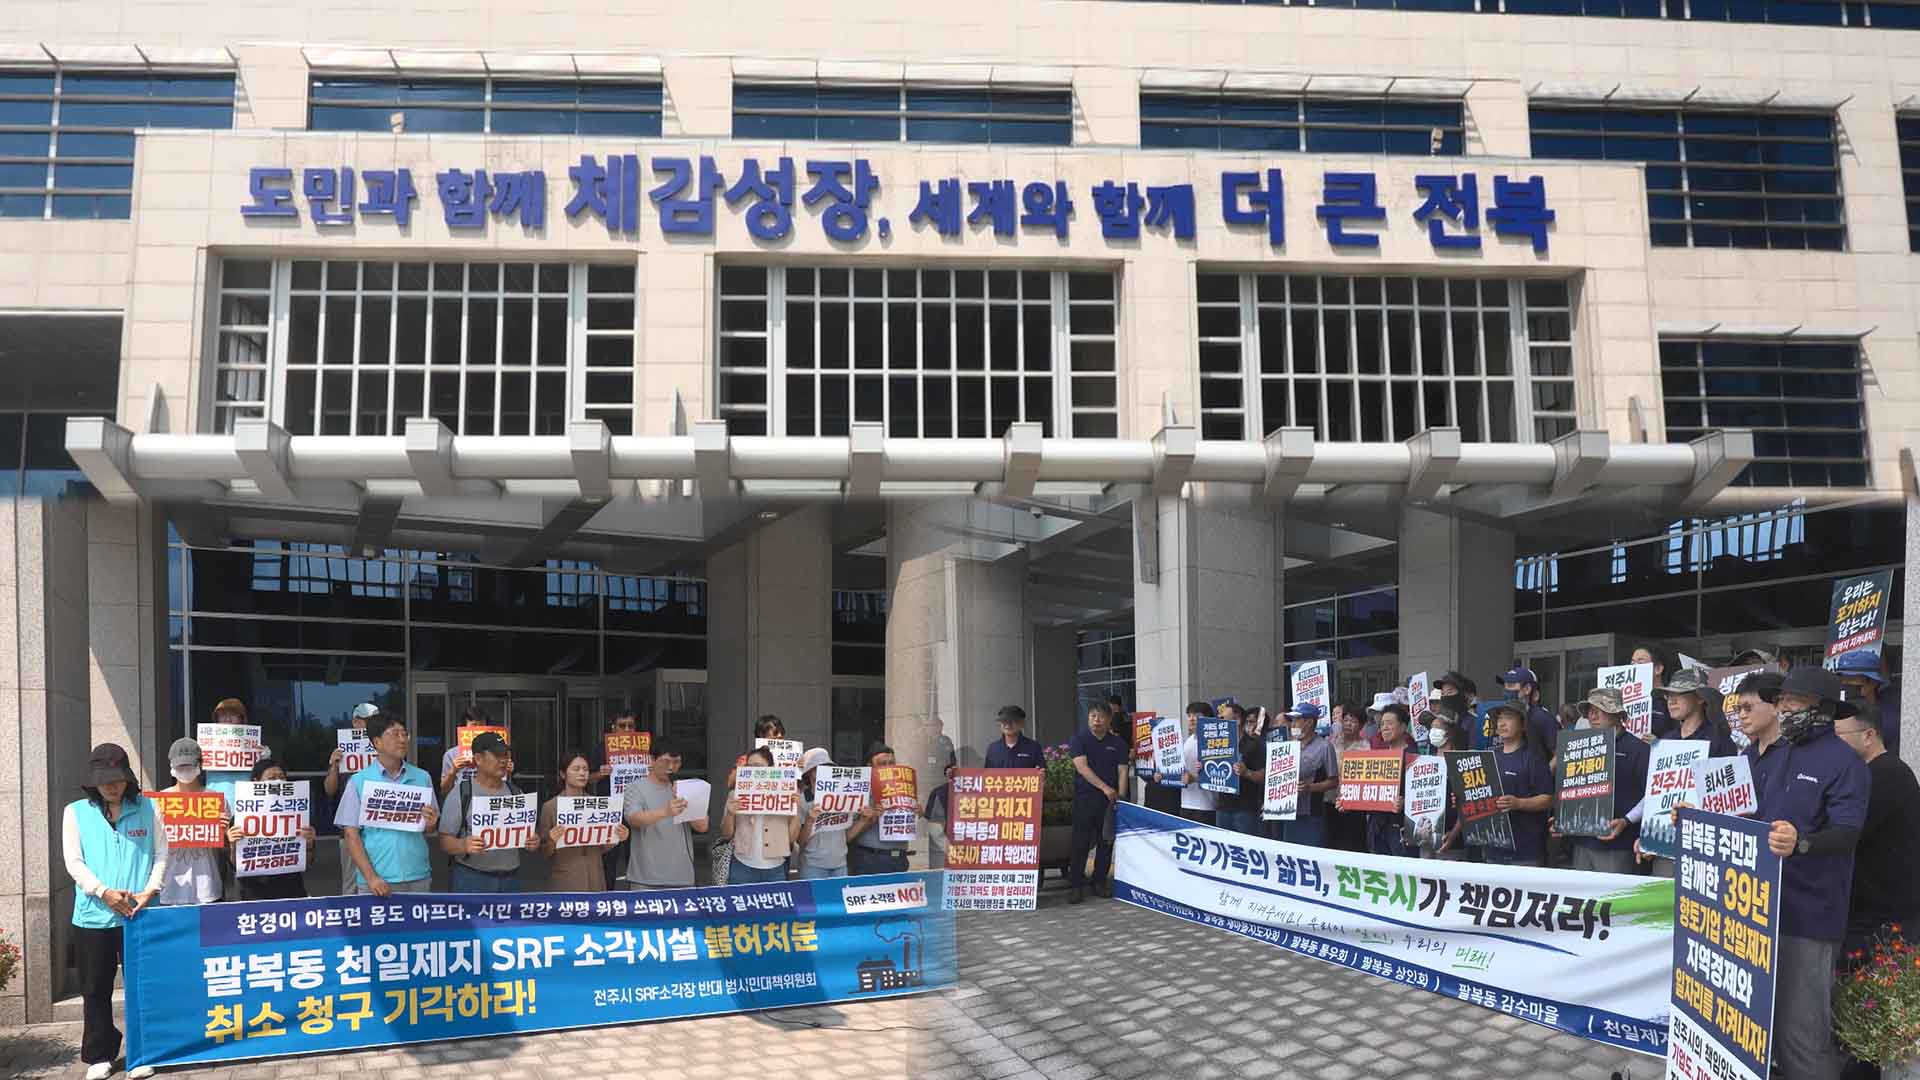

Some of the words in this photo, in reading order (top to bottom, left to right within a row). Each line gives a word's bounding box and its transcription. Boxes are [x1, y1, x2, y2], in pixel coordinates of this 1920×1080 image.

[241, 167, 418, 235] 도민과
[436, 168, 545, 239] 함께
[563, 154, 894, 243] 체감성장,
[908, 176, 1074, 240] 세계와
[1092, 179, 1196, 241] 함께
[1220, 167, 1284, 248] 더
[1316, 172, 1386, 249] 큰
[1412, 172, 1555, 254] 전북
[1842, 579, 1874, 603] 우리는
[1835, 591, 1882, 624] 포기하지
[1838, 609, 1878, 639] 않는다!
[1605, 668, 1636, 688] 전주시
[339, 743, 361, 753] SRF
[607, 735, 651, 751] 전주시장
[1271, 744, 1291, 761] 전주시
[202, 751, 258, 768] 중단하라
[1656, 754, 1673, 770] 회사
[832, 768, 861, 779] 팔복동
[1462, 768, 1486, 788] 회사
[1705, 764, 1736, 793] 회사를
[253, 783, 295, 797] 팔복동
[817, 780, 839, 792] SRF
[953, 776, 983, 793] 전주시
[984, 777, 1004, 793] 우수
[1005, 776, 1040, 793] 장수기업
[236, 800, 264, 812] SRF
[270, 799, 308, 812] 소각장
[489, 796, 526, 811] 팔복동
[573, 798, 609, 811] 팔복동
[737, 794, 793, 811] 중단하라
[822, 794, 865, 812] OUT!
[959, 797, 1033, 819] 천일제지
[243, 814, 301, 837] OUT!
[473, 813, 500, 826] SRF
[504, 810, 536, 825] 소각장
[558, 813, 582, 825] SRF
[587, 811, 621, 824] 소각장
[164, 824, 220, 843] 임져라!!
[480, 826, 531, 849] OUT!
[564, 825, 612, 845] OUT!
[953, 821, 999, 841] 팔복동의
[1001, 821, 1034, 841] 미래를
[1681, 818, 1716, 857] 팔복동
[1718, 827, 1758, 870] 주민과
[242, 854, 299, 872] 기각하라
[1004, 845, 1037, 865] 책임져라!
[847, 894, 867, 907] SRF
[869, 891, 896, 905] 소각장
[897, 886, 924, 904] NO!
[1172, 832, 1205, 865] 우리
[1210, 840, 1269, 880] 가족의
[1275, 854, 1330, 897] 삶터,
[1334, 864, 1450, 917] 전주시가
[1459, 881, 1613, 941] 책임져라!
[1680, 854, 1720, 900] 함께한
[1723, 867, 1770, 927] 39년
[237, 911, 297, 936] 환경이
[305, 908, 361, 930] 아프면
[369, 905, 405, 926] 몸도
[412, 903, 471, 924] 아프다.
[479, 902, 512, 922] 시민
[519, 900, 552, 920] 건강
[558, 899, 591, 919] 생명
[595, 897, 628, 918] 위협
[633, 896, 679, 916] 쓰레기
[684, 894, 727, 915] 소각장
[731, 891, 795, 913] 결사반대!
[1291, 935, 1318, 953] 팔복동
[1679, 895, 1721, 944] 향토기업
[1723, 918, 1771, 974] 천일제지
[203, 949, 326, 997] 팔복동
[335, 938, 481, 985] 천일제지
[491, 937, 565, 972] SRF
[573, 926, 699, 967] 소각시설
[704, 920, 819, 960] 불허처분
[1455, 946, 1495, 968] 미래!
[1362, 956, 1392, 977] 팔복동
[1395, 963, 1429, 987] 상인회
[1687, 938, 1753, 1008] 지역경제와
[593, 987, 633, 1008] 전주시
[635, 982, 697, 1004] SRF소각장
[699, 979, 723, 1000] 반대
[725, 971, 817, 997] 범시민대책위원회
[204, 1000, 287, 1044] 취소
[297, 991, 375, 1036] 청구
[384, 978, 537, 1027] 기각하라!
[1457, 983, 1497, 1008] 팔복동
[1500, 995, 1560, 1025] 감수마을
[1676, 968, 1714, 1022] 일자리를
[1716, 997, 1768, 1065] 지켜내자!
[1674, 1016, 1702, 1059] 전주시의
